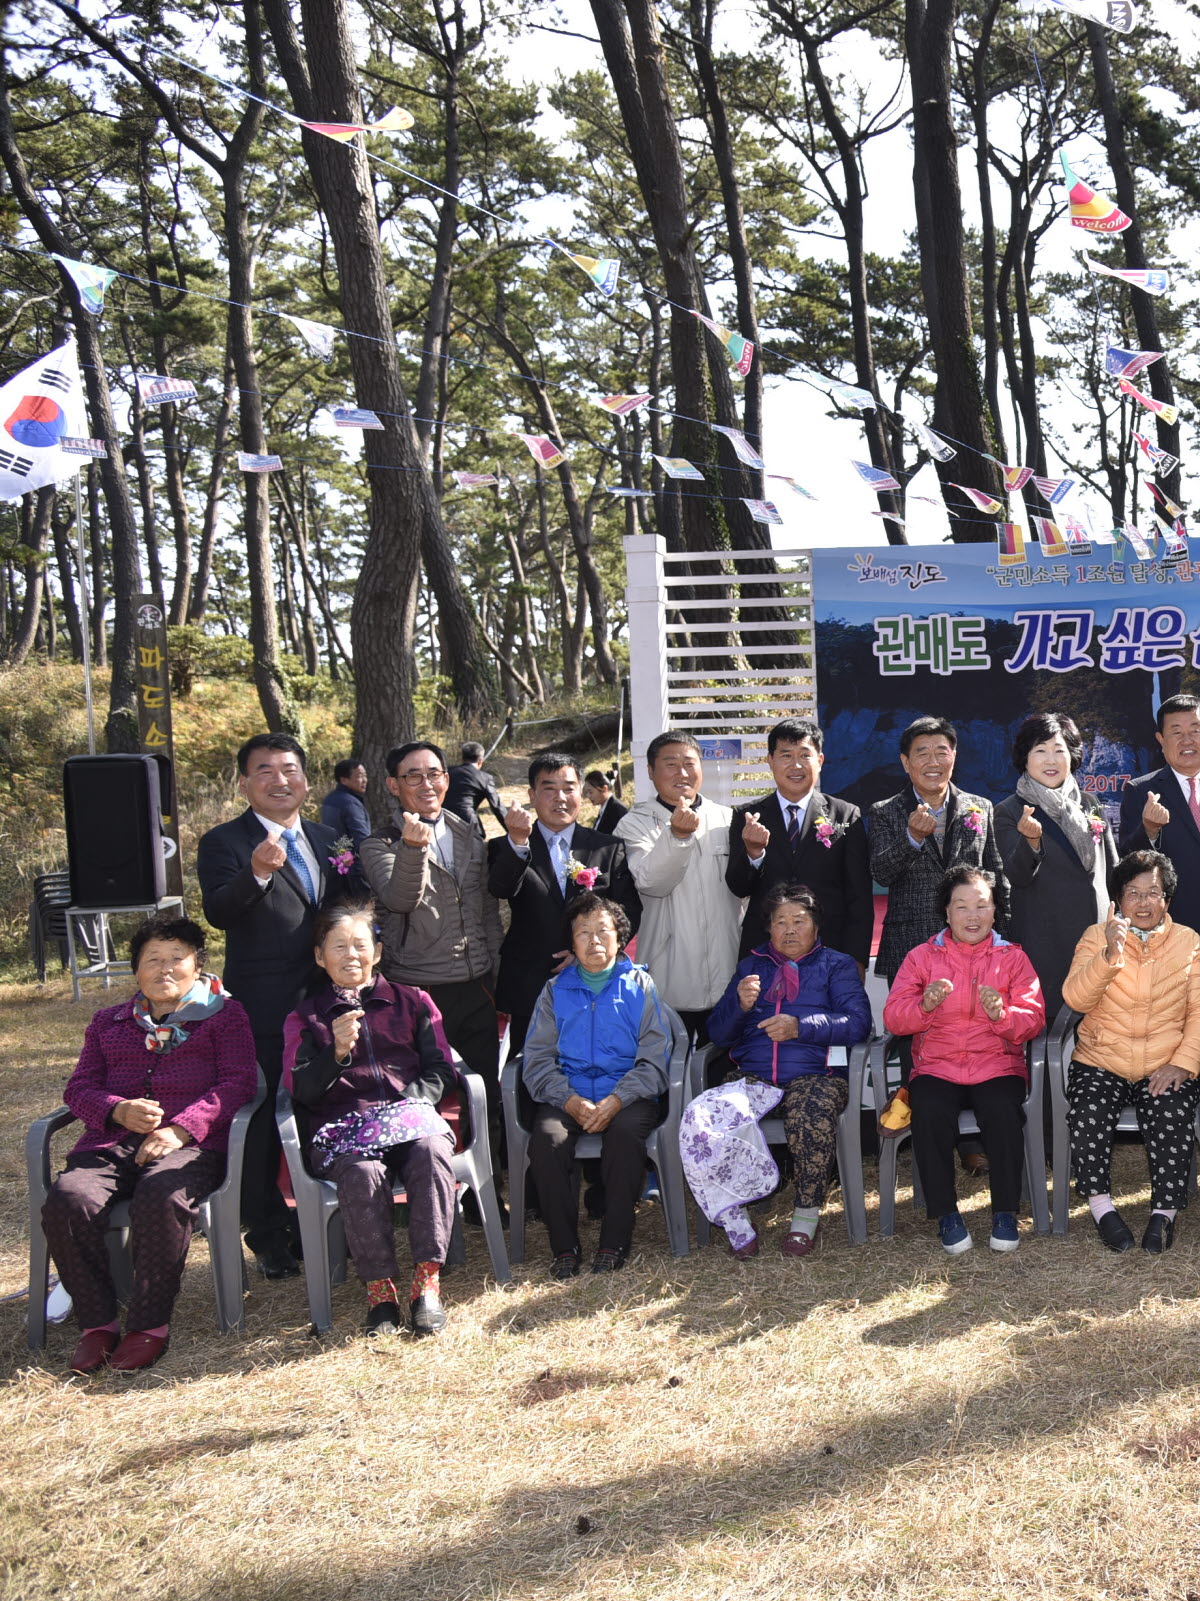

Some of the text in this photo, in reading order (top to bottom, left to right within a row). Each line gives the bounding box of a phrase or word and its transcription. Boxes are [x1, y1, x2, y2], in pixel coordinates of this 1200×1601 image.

[859, 562, 947, 590] 보배섬 진도
[873, 614, 991, 675] 관매도
[1004, 609, 1095, 674] 가고
[1098, 606, 1187, 673] 싶은
[1084, 774, 1132, 792] 2017
